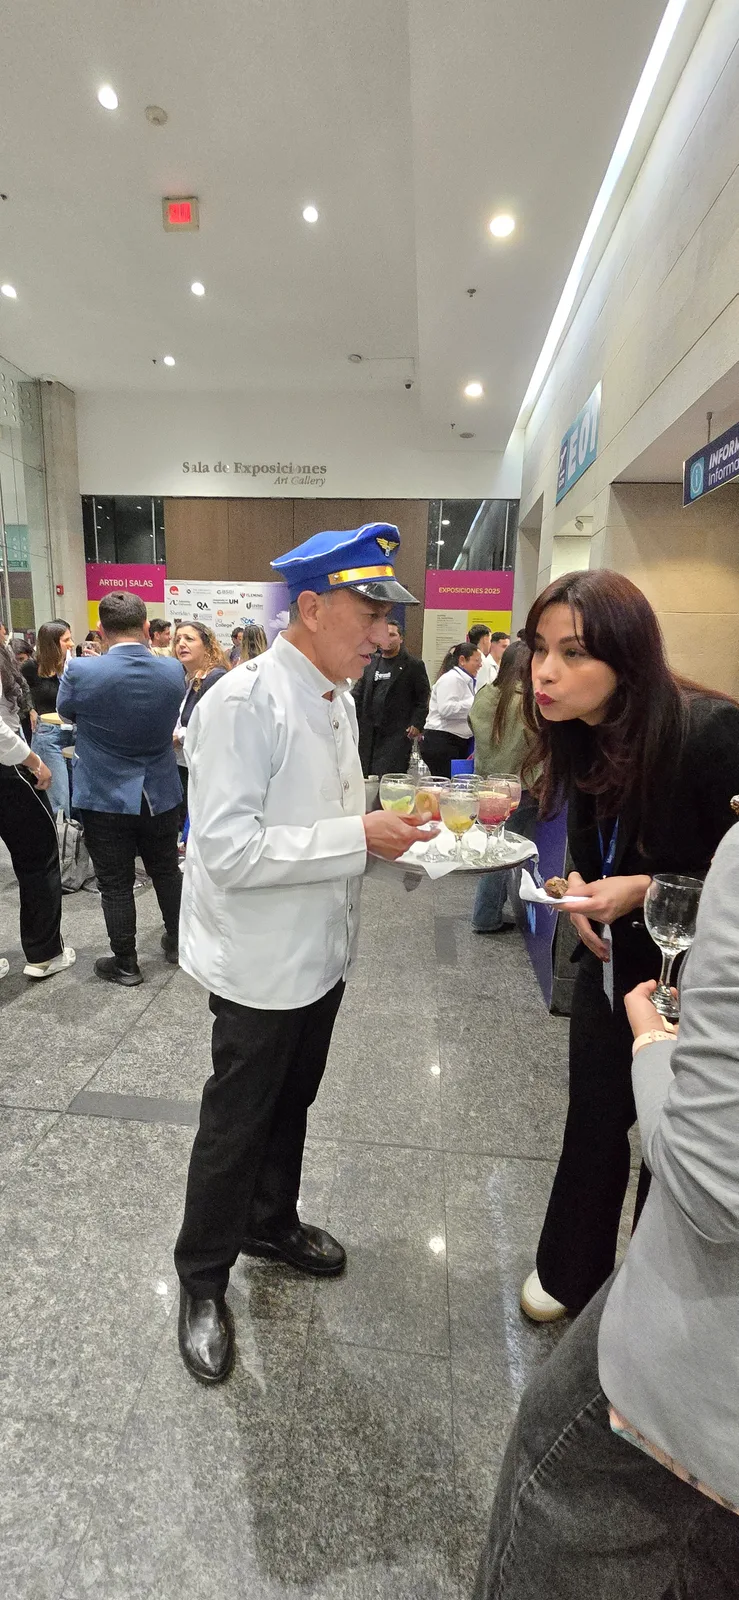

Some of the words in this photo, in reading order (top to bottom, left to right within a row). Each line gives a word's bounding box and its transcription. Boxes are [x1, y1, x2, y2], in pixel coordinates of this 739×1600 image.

[567, 400, 600, 480] E01
[182, 461, 210, 474] Sala
[213, 461, 230, 474] de
[233, 462, 327, 477] Exposiciones
[274, 476, 288, 485] Art
[290, 475, 326, 487] Gallery
[99, 578, 124, 587] ARTBO
[129, 579, 154, 588] SALAS
[484, 587, 501, 595] 2025
[197, 602, 208, 610] QA
